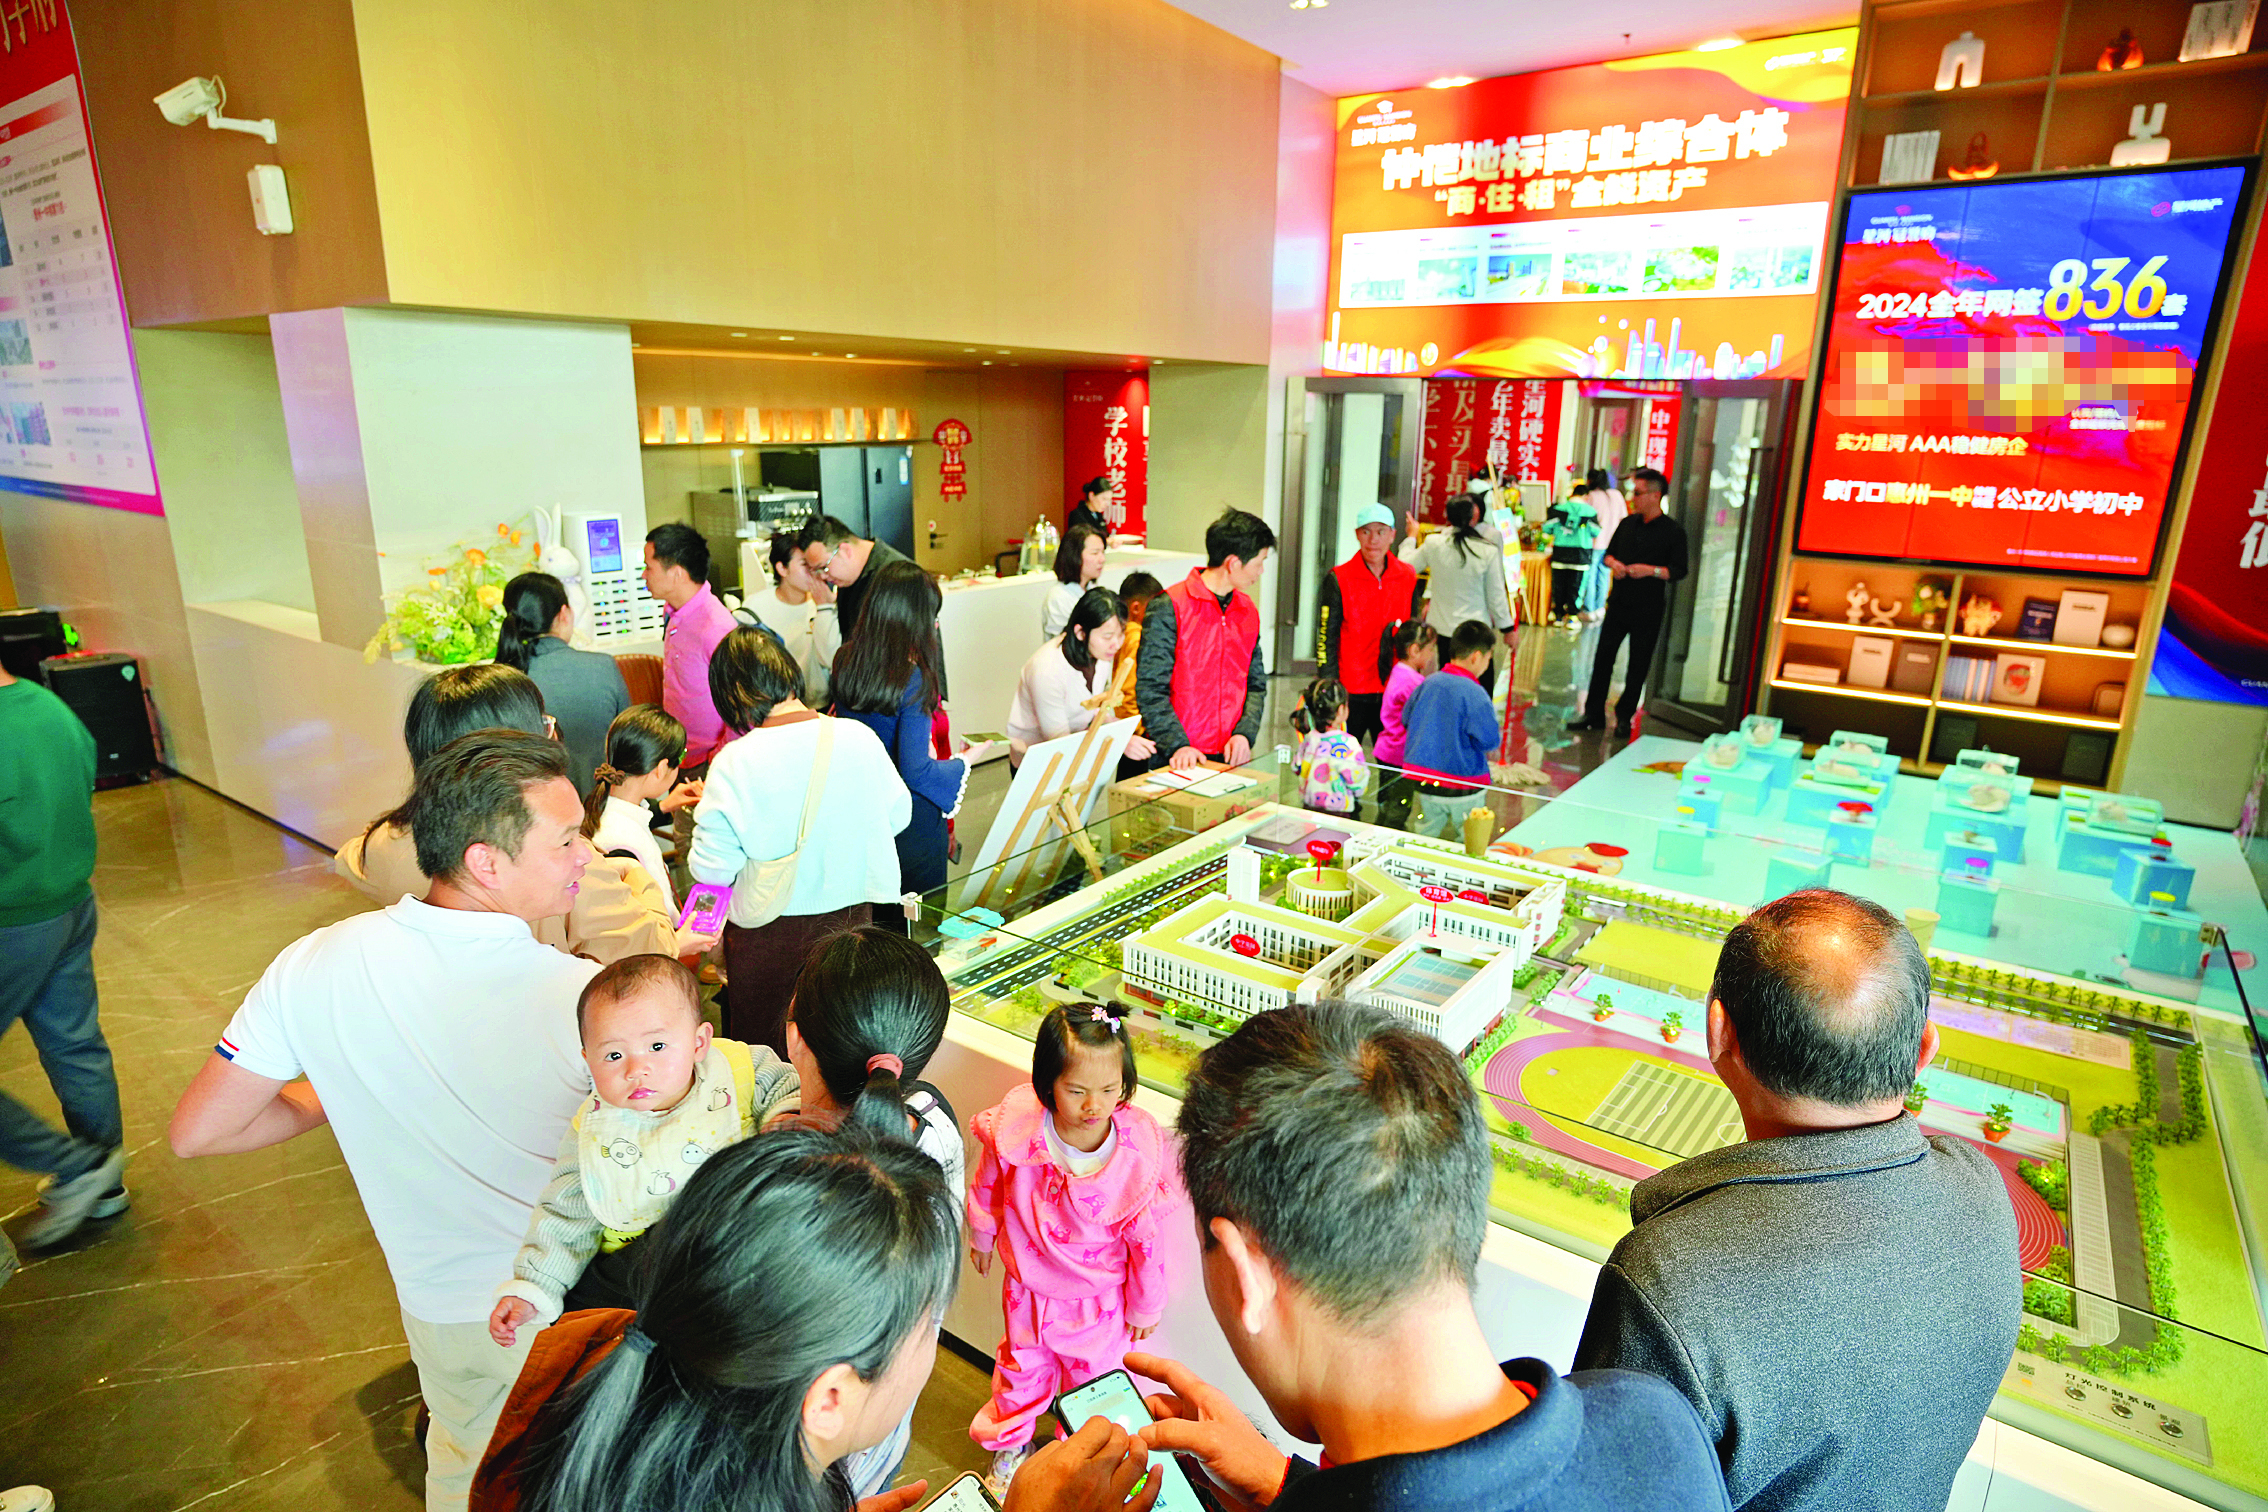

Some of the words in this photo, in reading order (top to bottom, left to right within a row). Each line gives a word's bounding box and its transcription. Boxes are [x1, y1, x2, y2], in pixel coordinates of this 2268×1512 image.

[1381, 107, 1790, 191] 仲恺地标商业综合体
[1835, 433, 1909, 453] 实力星河
[1909, 435, 2029, 456] AAA稳健房企
[1997, 487, 2144, 516] 公立小学初中
